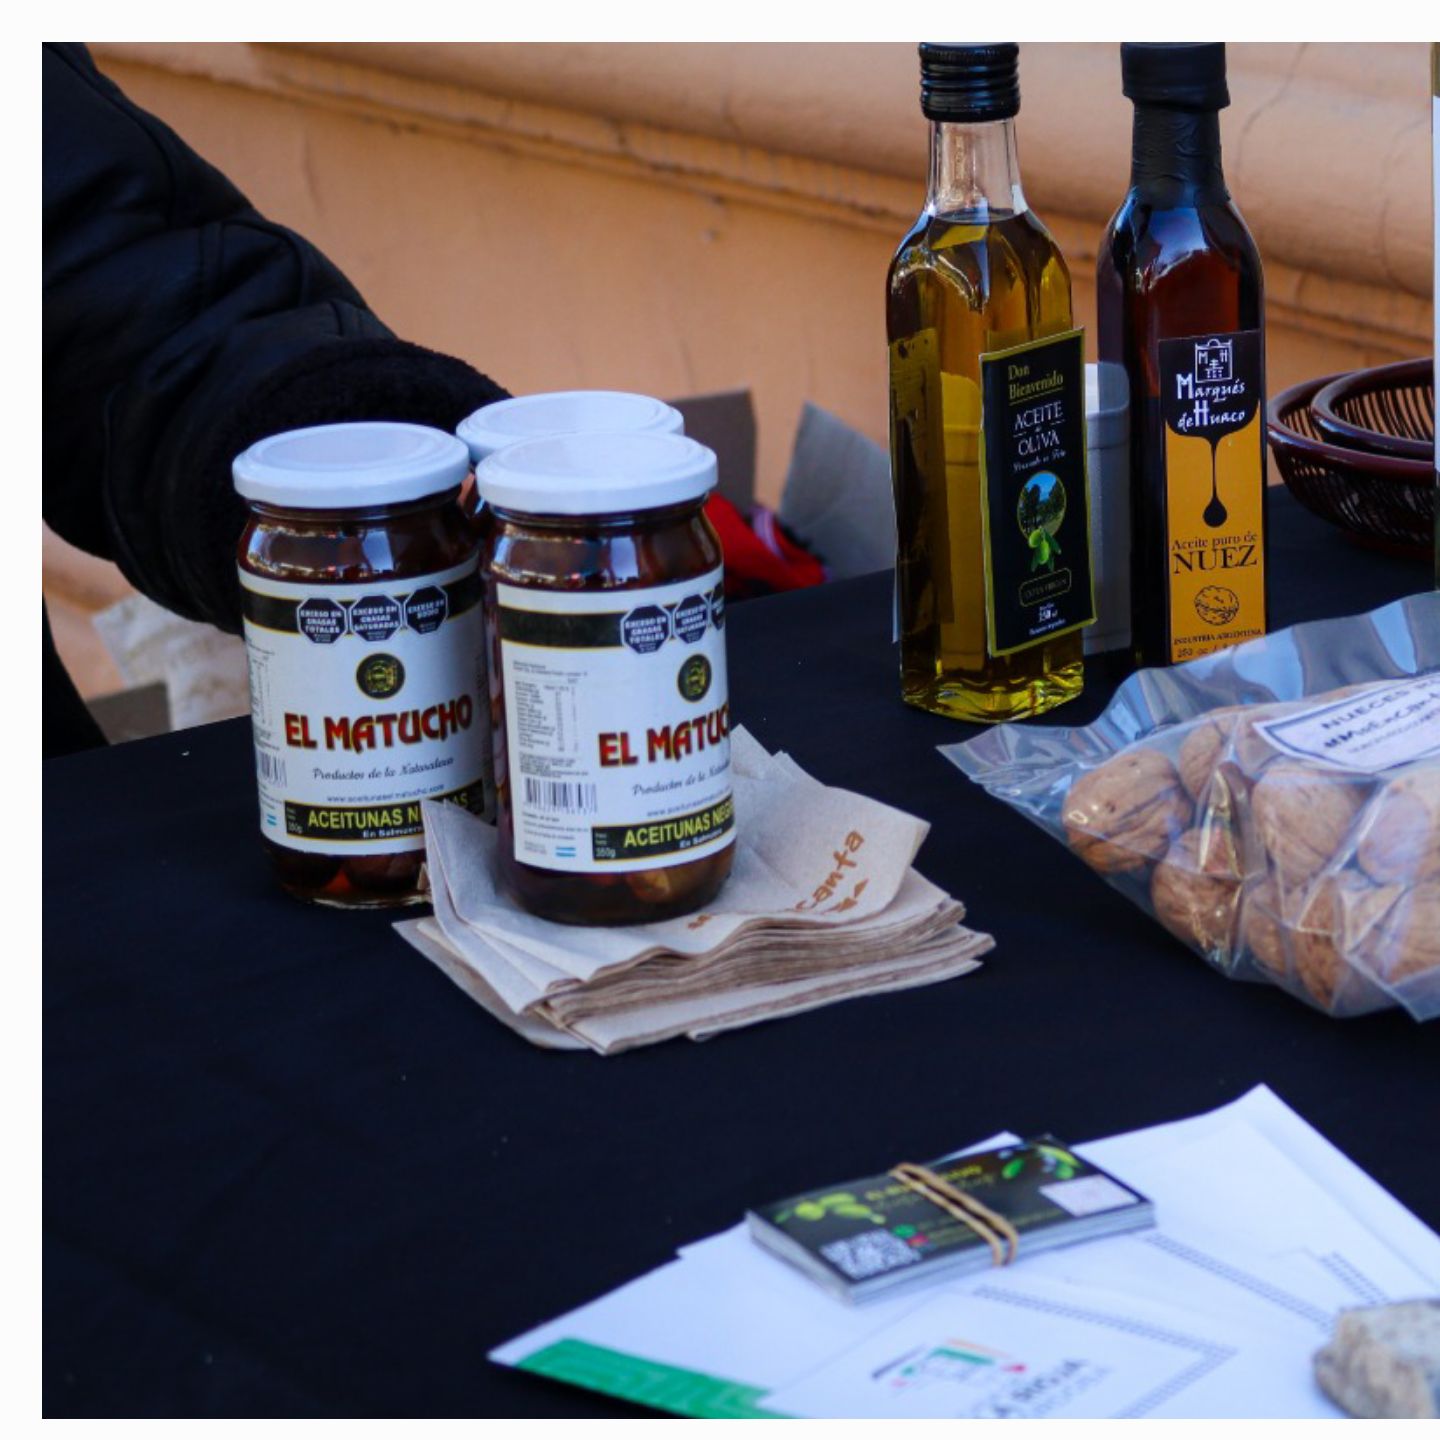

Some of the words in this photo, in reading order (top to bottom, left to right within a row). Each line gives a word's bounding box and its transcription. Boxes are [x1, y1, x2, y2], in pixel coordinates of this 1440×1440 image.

[1176, 373, 1246, 403] Marqués
[1014, 401, 1064, 431] ACEITE
[1177, 412, 1195, 433] de
[1194, 400, 1246, 427] Huaco
[1018, 429, 1061, 457] OLIVA
[1172, 536, 1209, 551] Aceite
[1212, 533, 1240, 549] puro
[1243, 530, 1258, 542] de
[1173, 544, 1258, 575] NUEZ
[284, 712, 318, 749] EL
[323, 694, 474, 755] MATUCHO
[598, 731, 639, 768] EL
[312, 767, 365, 781] Productos
[368, 766, 382, 779] de
[307, 807, 404, 830] ACEITUNAS
[623, 813, 712, 848] ACEITUNAS
